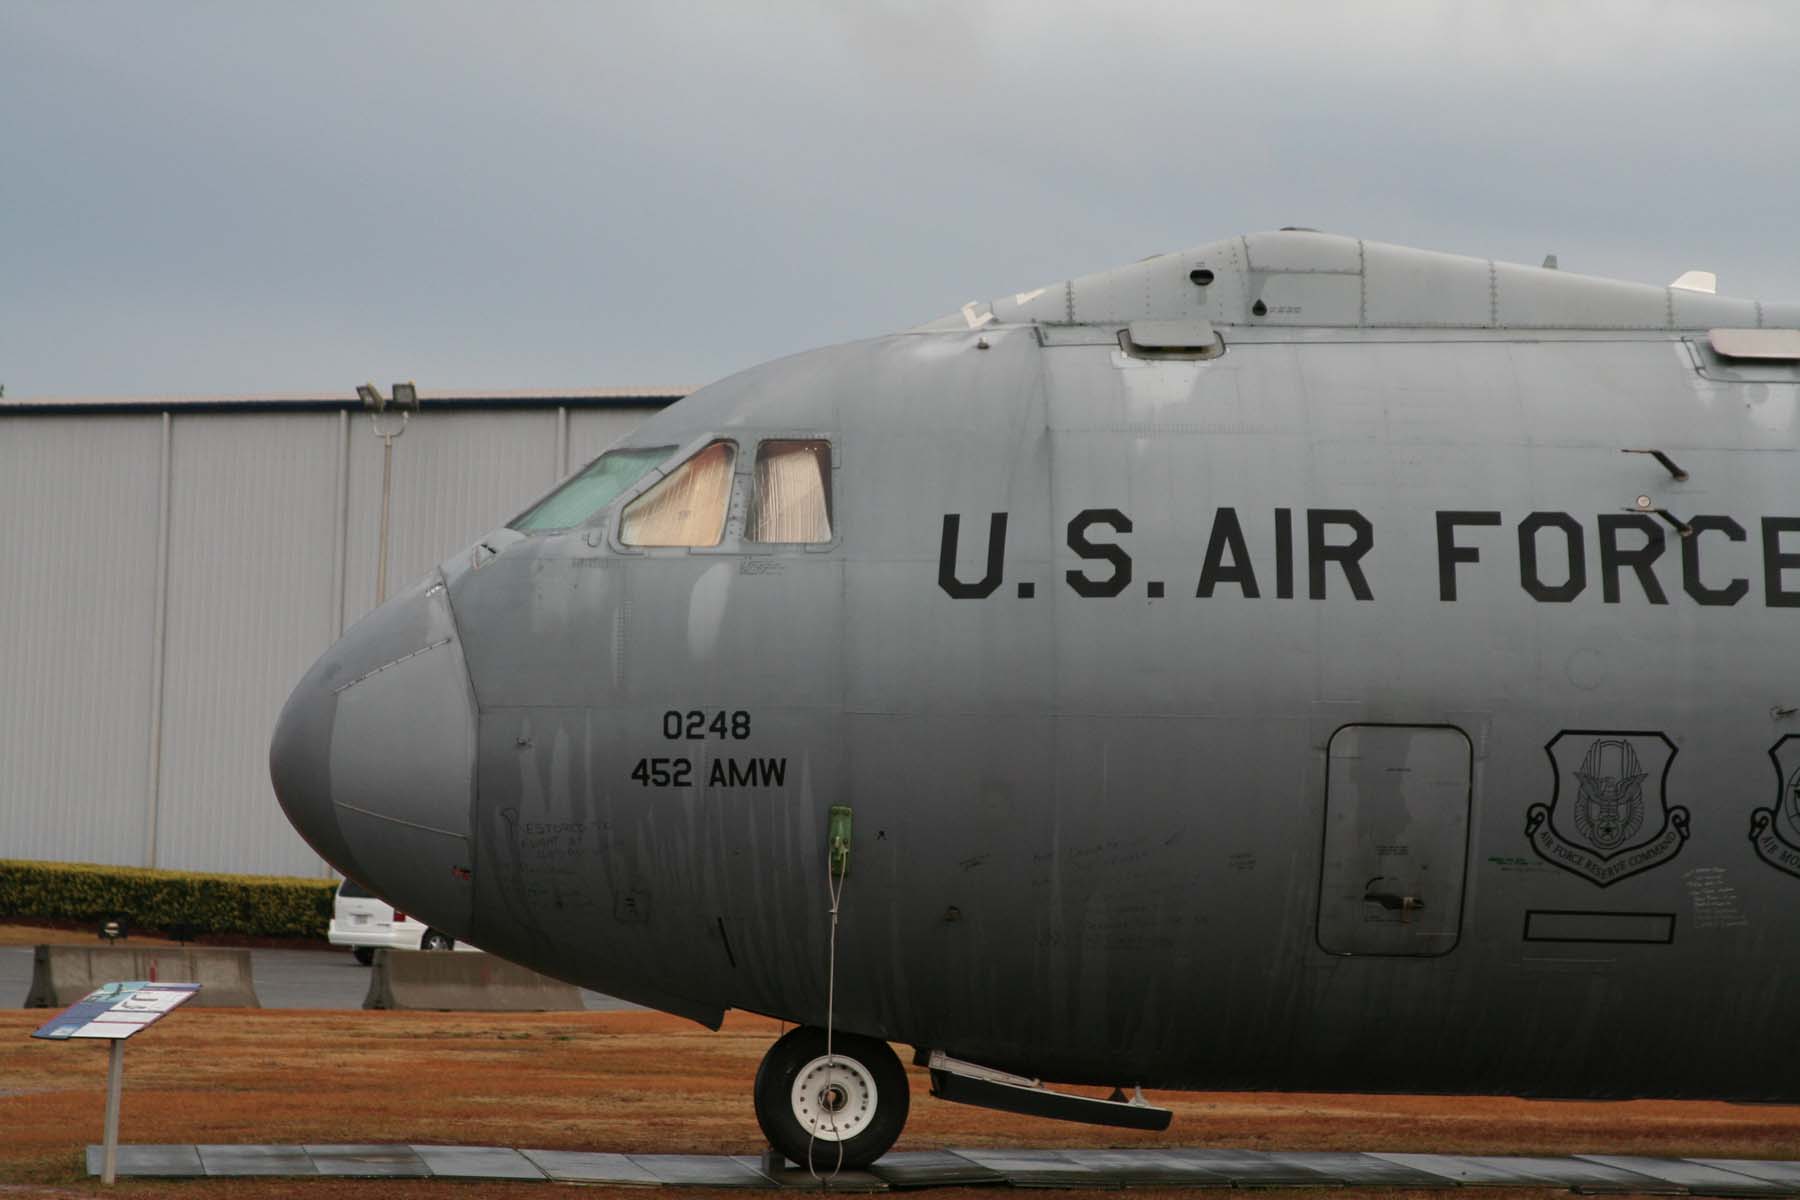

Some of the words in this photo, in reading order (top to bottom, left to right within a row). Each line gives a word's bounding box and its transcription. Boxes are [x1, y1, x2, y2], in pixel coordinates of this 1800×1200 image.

[938, 508, 1165, 599] U.S.
[1195, 507, 1375, 600] AIR
[1436, 510, 1800, 608] FORCE
[662, 710, 751, 740] 0248
[631, 757, 692, 788] 452
[709, 757, 787, 788] AMW
[1541, 831, 1554, 848] AIR
[1553, 844, 1584, 865] FORCE
[1584, 859, 1627, 879] RESERVE
[1629, 831, 1676, 866] COMMAND
[1761, 836, 1778, 855] AIR
[1779, 850, 1800, 868] MO
